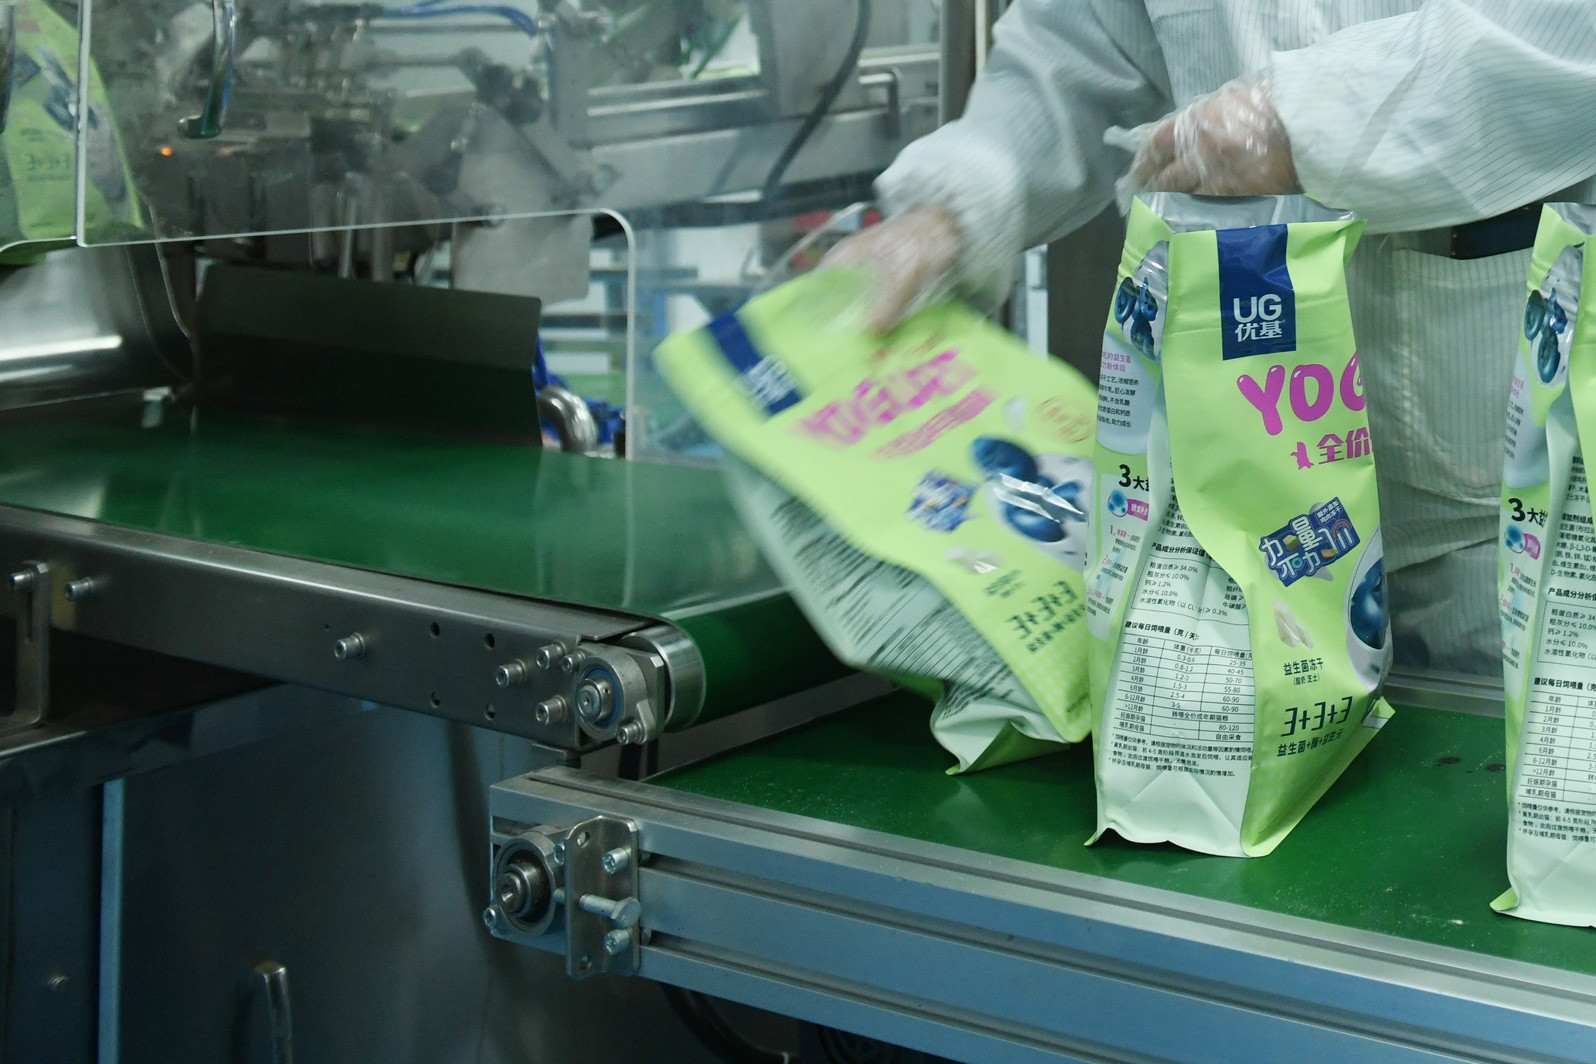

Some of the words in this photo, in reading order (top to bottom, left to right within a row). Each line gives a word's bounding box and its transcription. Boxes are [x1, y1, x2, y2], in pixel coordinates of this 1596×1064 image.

[1233, 293, 1282, 322] UG
[1235, 320, 1283, 342] 优基
[1283, 658, 1324, 676] 益生菌冻干
[1224, 686, 1241, 694] 55-80
[1280, 696, 1353, 737] 3+3+3
[1218, 724, 1240, 732] 80-120
